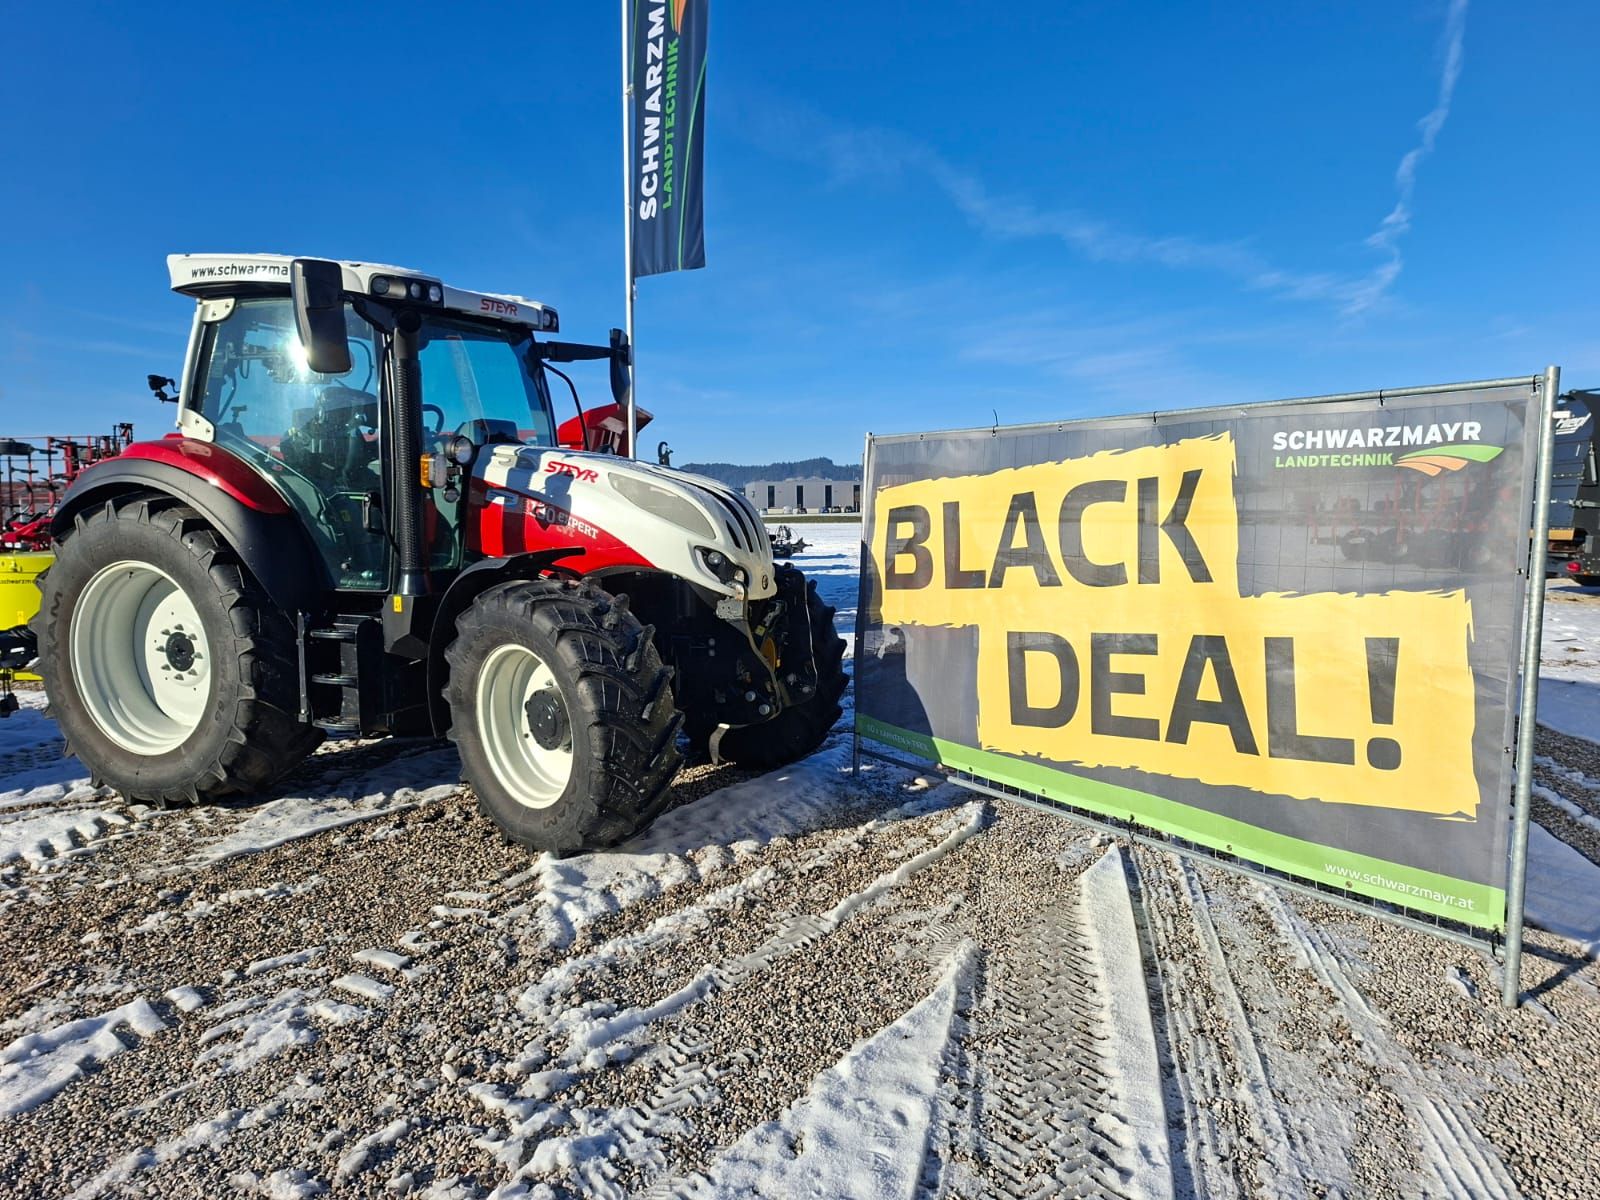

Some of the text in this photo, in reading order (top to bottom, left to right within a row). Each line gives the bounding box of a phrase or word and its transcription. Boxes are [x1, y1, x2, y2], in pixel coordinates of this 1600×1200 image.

[639, 0, 666, 220] SCHWARZM
[662, 37, 679, 209] LANDTECHNIK
[480, 298, 518, 317] STEYR
[1272, 421, 1482, 450] SCHWARZMAYR
[544, 460, 600, 484] STEYR
[1275, 452, 1393, 468] LANDTECHNIK
[557, 512, 599, 540] EXPERT
[884, 468, 1214, 591] BLACK
[1006, 630, 1403, 771] DEAL!
[1324, 862, 1476, 912] www.schwarzmayr.at
